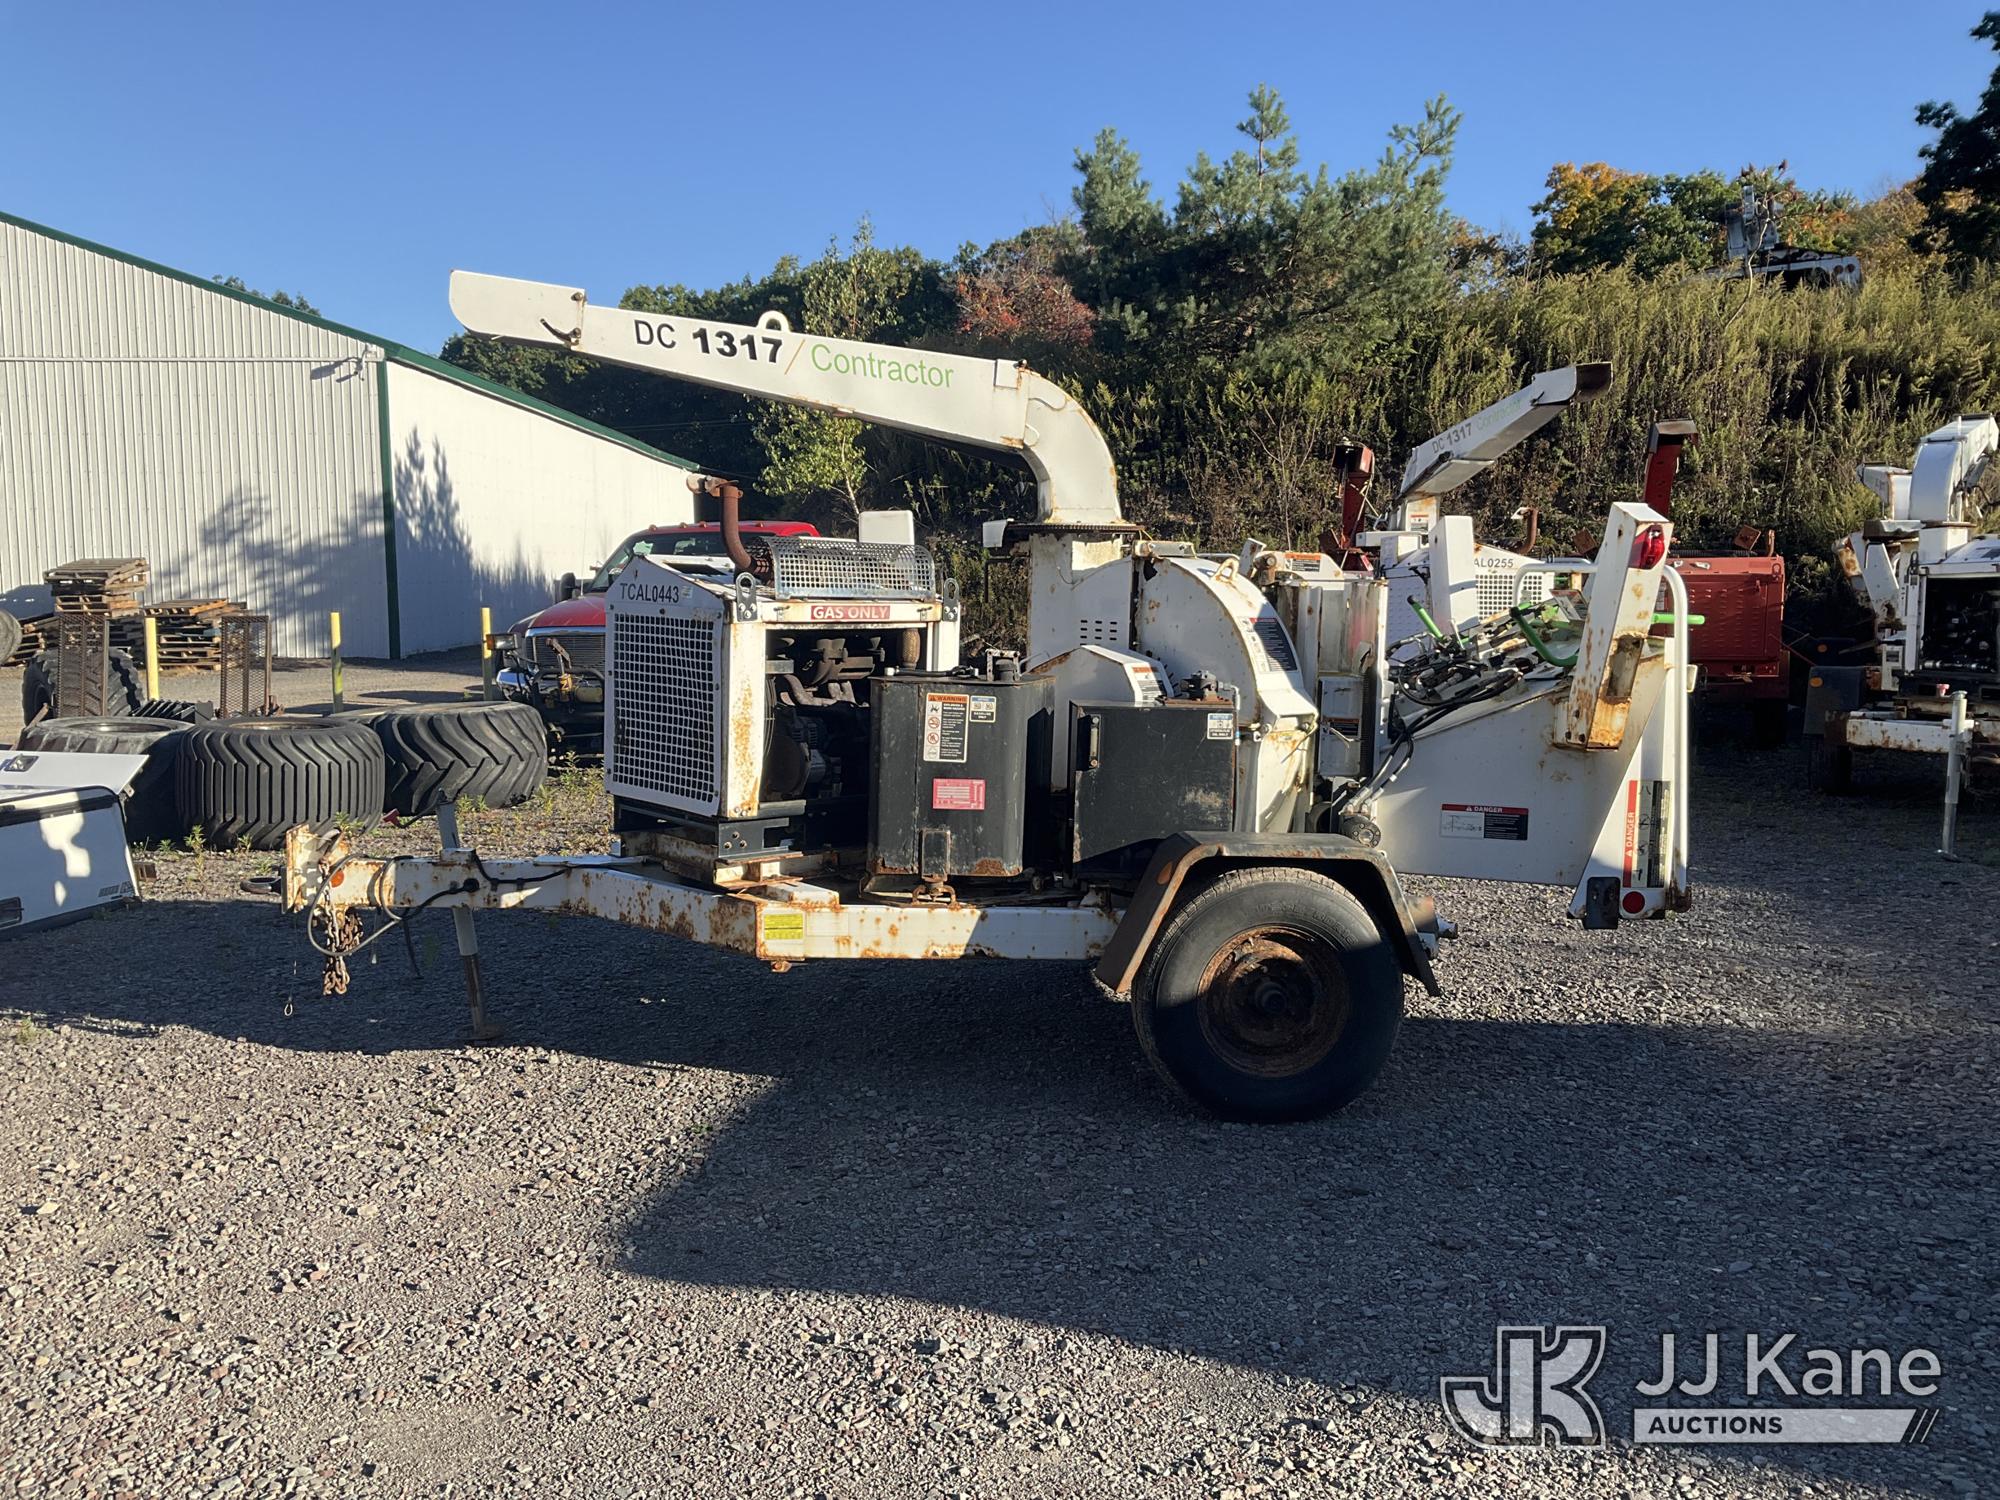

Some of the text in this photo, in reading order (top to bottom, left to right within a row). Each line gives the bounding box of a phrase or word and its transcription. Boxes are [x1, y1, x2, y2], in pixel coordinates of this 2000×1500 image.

[635, 319, 953, 388] DC 1317 Contractor
[1432, 437, 1445, 453] DC
[1446, 422, 1472, 446] 1317
[620, 583, 679, 603] TCAL0443
[813, 606, 888, 619] GAS ONLY
[1626, 812, 1635, 848] DANGER
